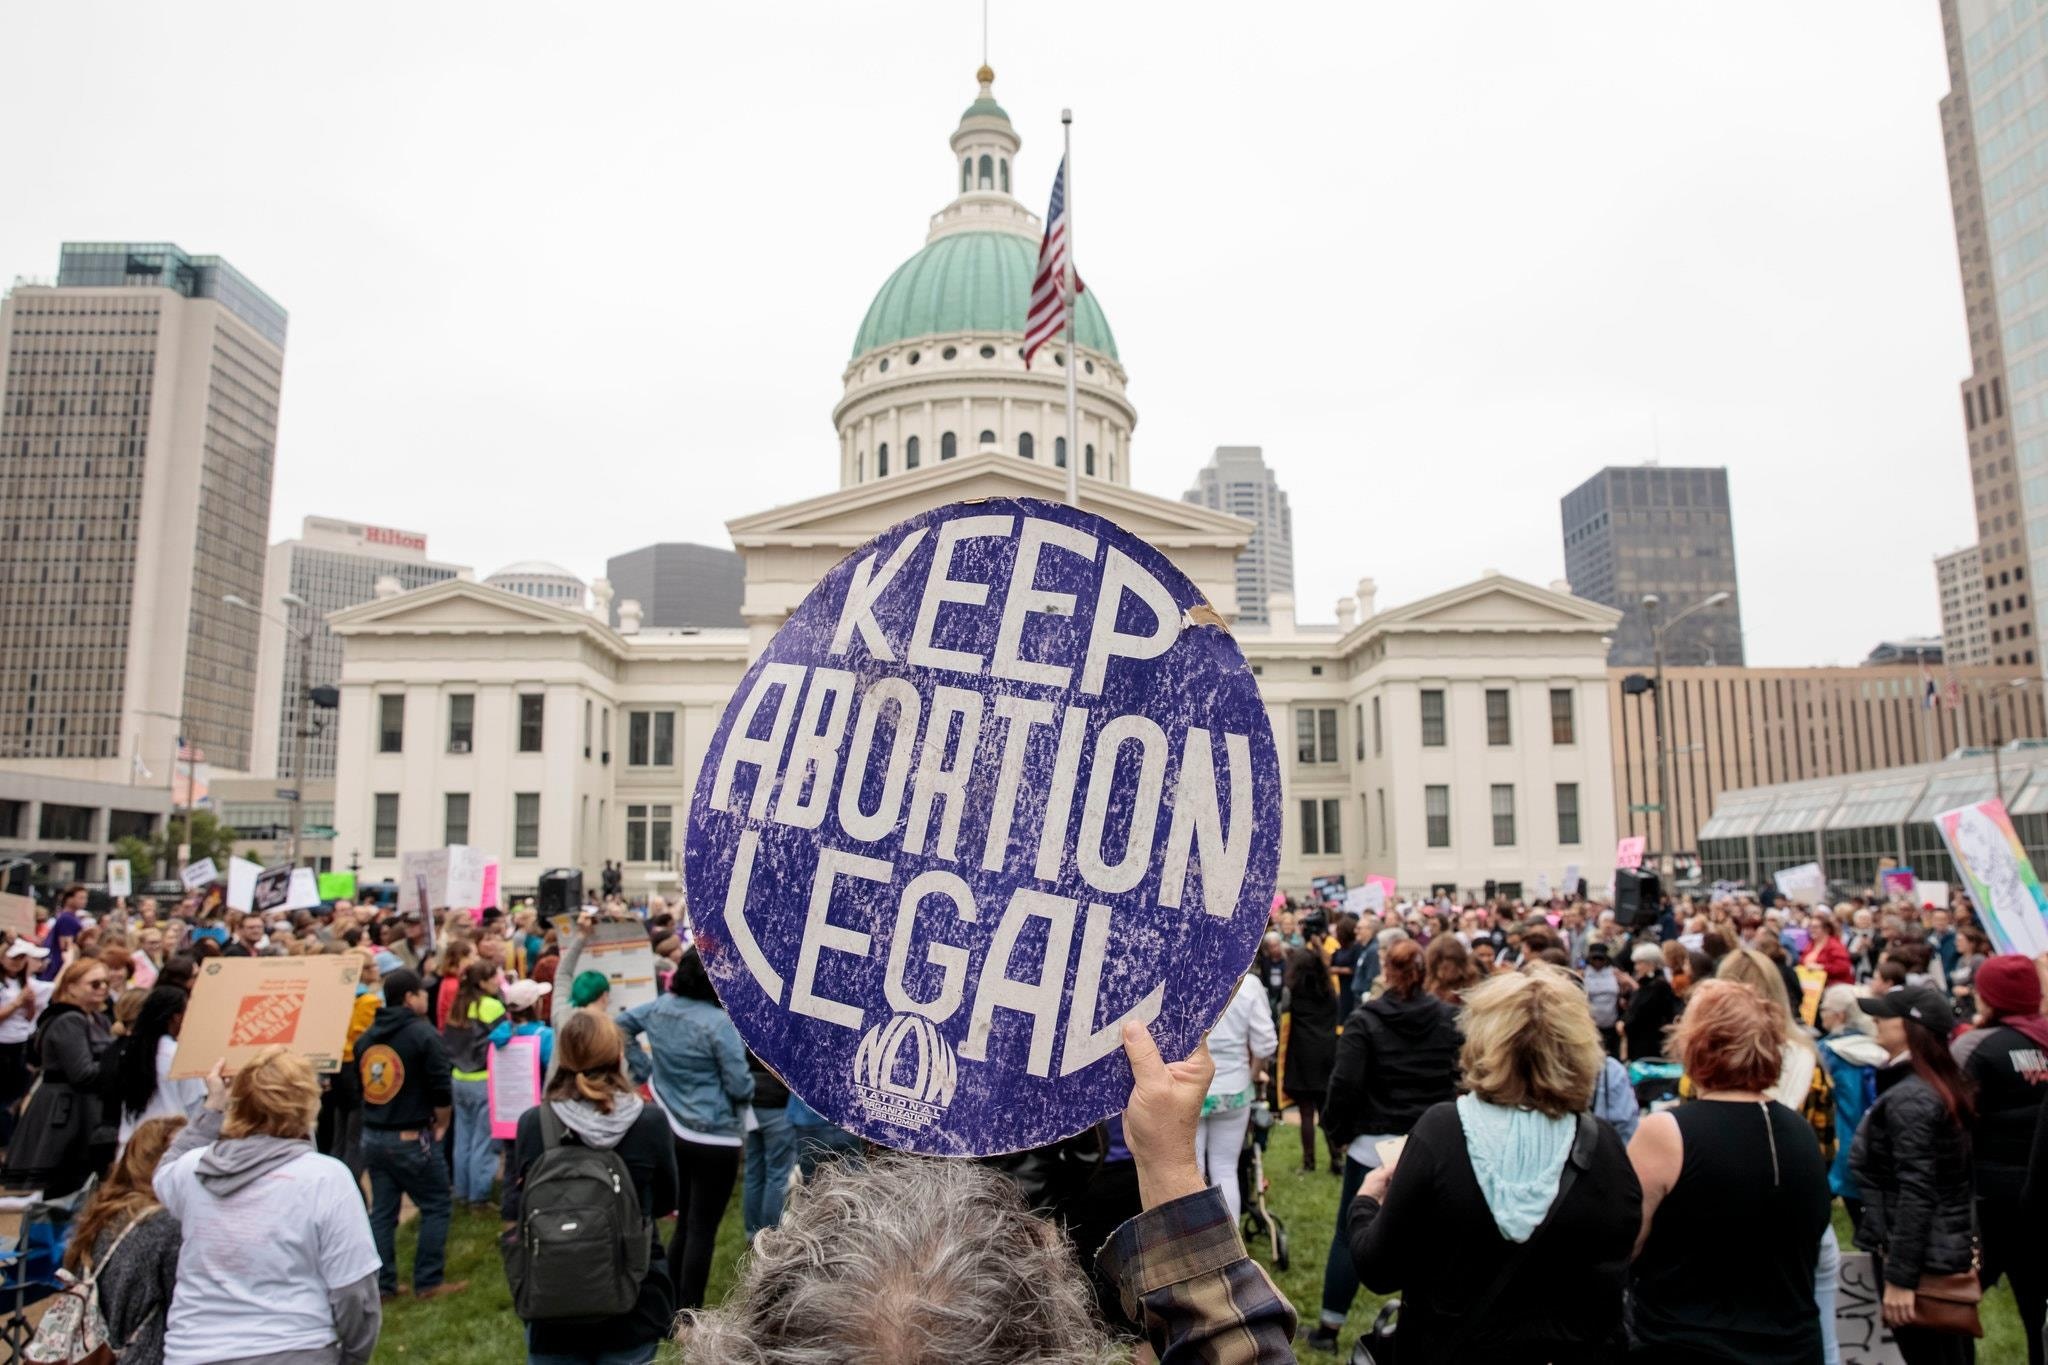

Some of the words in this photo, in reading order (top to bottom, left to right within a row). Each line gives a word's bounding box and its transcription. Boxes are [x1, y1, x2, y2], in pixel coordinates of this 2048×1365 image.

[366, 526, 426, 551] Hilton
[830, 515, 1182, 696] KEEP
[709, 663, 1253, 919] ABORTION
[723, 830, 1166, 1078] LEGAL
[854, 1015, 957, 1108] NOW
[858, 1087, 941, 1117] NATIONAL
[862, 1100, 932, 1124] ORGANIZATION
[871, 1110, 887, 1120] FOR
[888, 1113, 921, 1128] WOMEN
